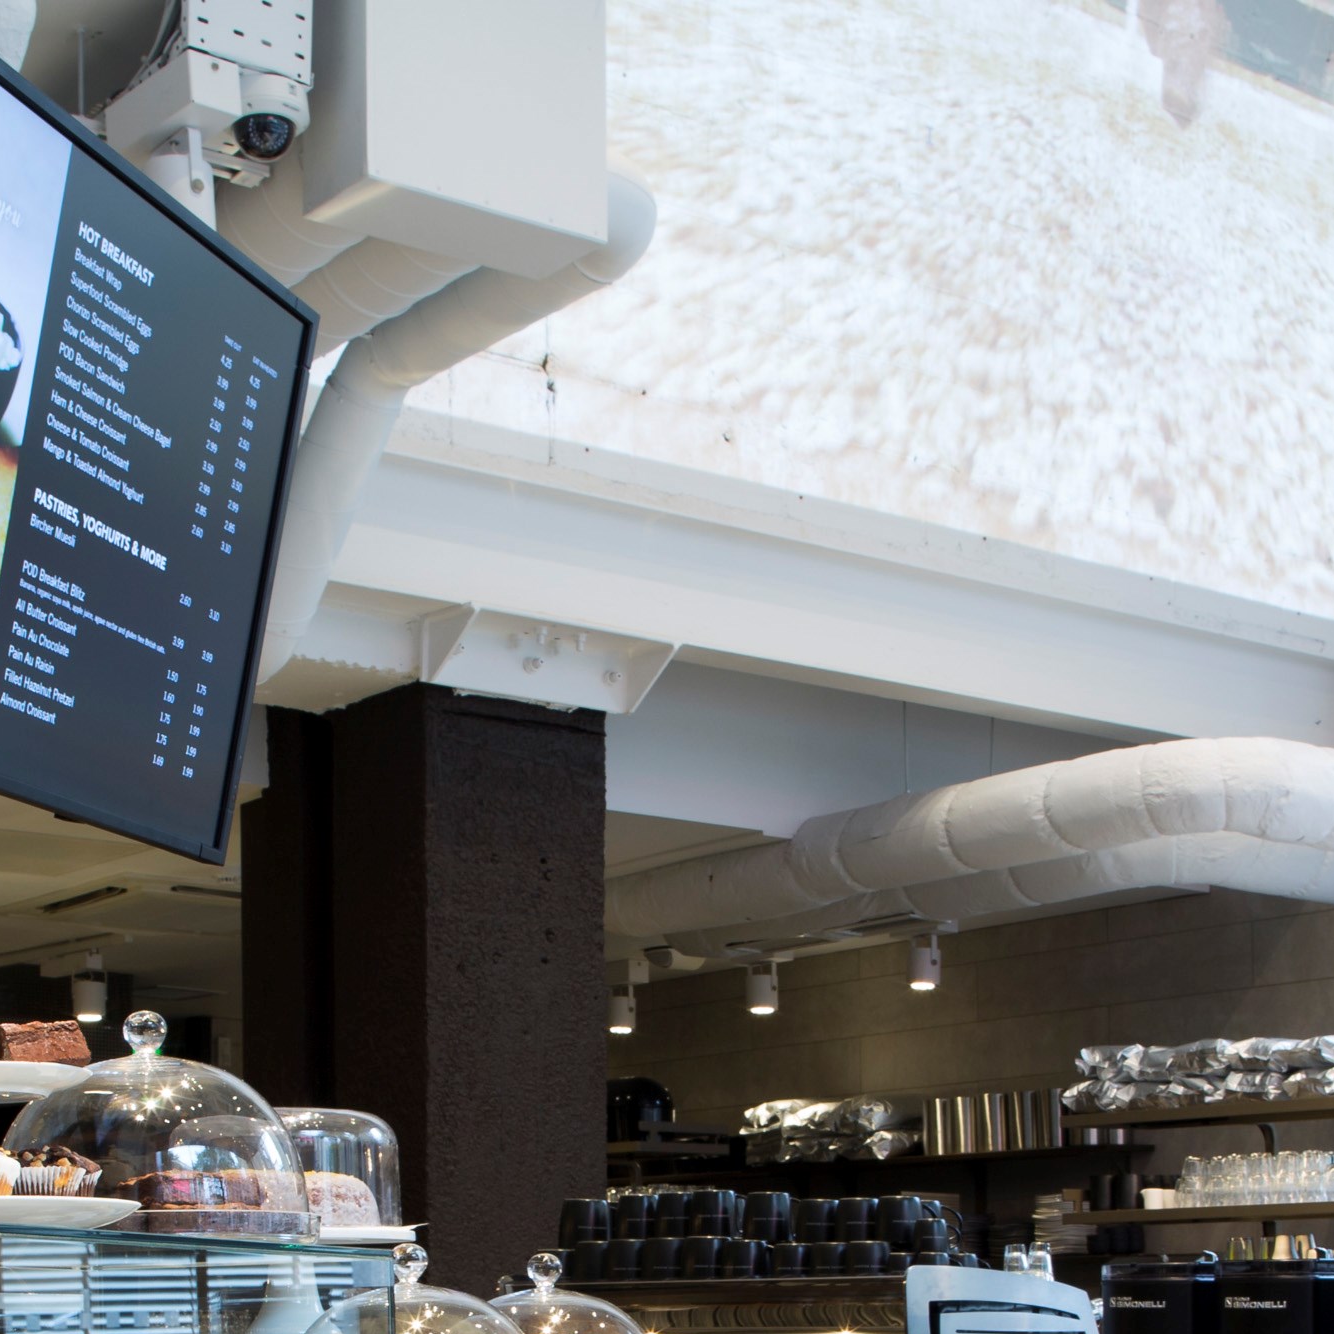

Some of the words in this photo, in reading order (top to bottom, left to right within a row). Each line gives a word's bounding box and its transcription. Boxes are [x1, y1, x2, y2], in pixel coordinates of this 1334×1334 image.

[75, 248, 105, 279] Breakfast
[106, 269, 122, 290] Wrap
[79, 221, 101, 247] HOT
[101, 238, 154, 286] BREAKFAST
[71, 271, 103, 303] Superfood
[104, 295, 136, 326] Scrambled
[137, 317, 151, 337] Eggs
[30, 513, 54, 535] Bircher
[55, 526, 76, 547] Muesli
[34, 488, 79, 526] PASTRIES,
[83, 513, 131, 551] YOGHURTS
[131, 541, 139, 556] &
[140, 545, 167, 570] MORE
[22, 560, 38, 578] POD
[39, 568, 69, 594] Breakfast
[70, 584, 85, 601] Blitz
[16, 598, 26, 612] All
[26, 603, 47, 621] Butter
[48, 613, 77, 636] Croissant
[12, 621, 27, 638] Pain
[28, 629, 38, 643] Au
[39, 634, 69, 657] Chocolate
[8, 645, 23, 661] Pain
[24, 652, 34, 666] Au
[35, 656, 54, 674] Raisin
[4, 668, 23, 686] Filled
[24, 676, 52, 698] Hazelnut
[53, 688, 74, 707] Pretzel
[0, 692, 26, 712] Almond
[27, 703, 56, 724] Croissant
